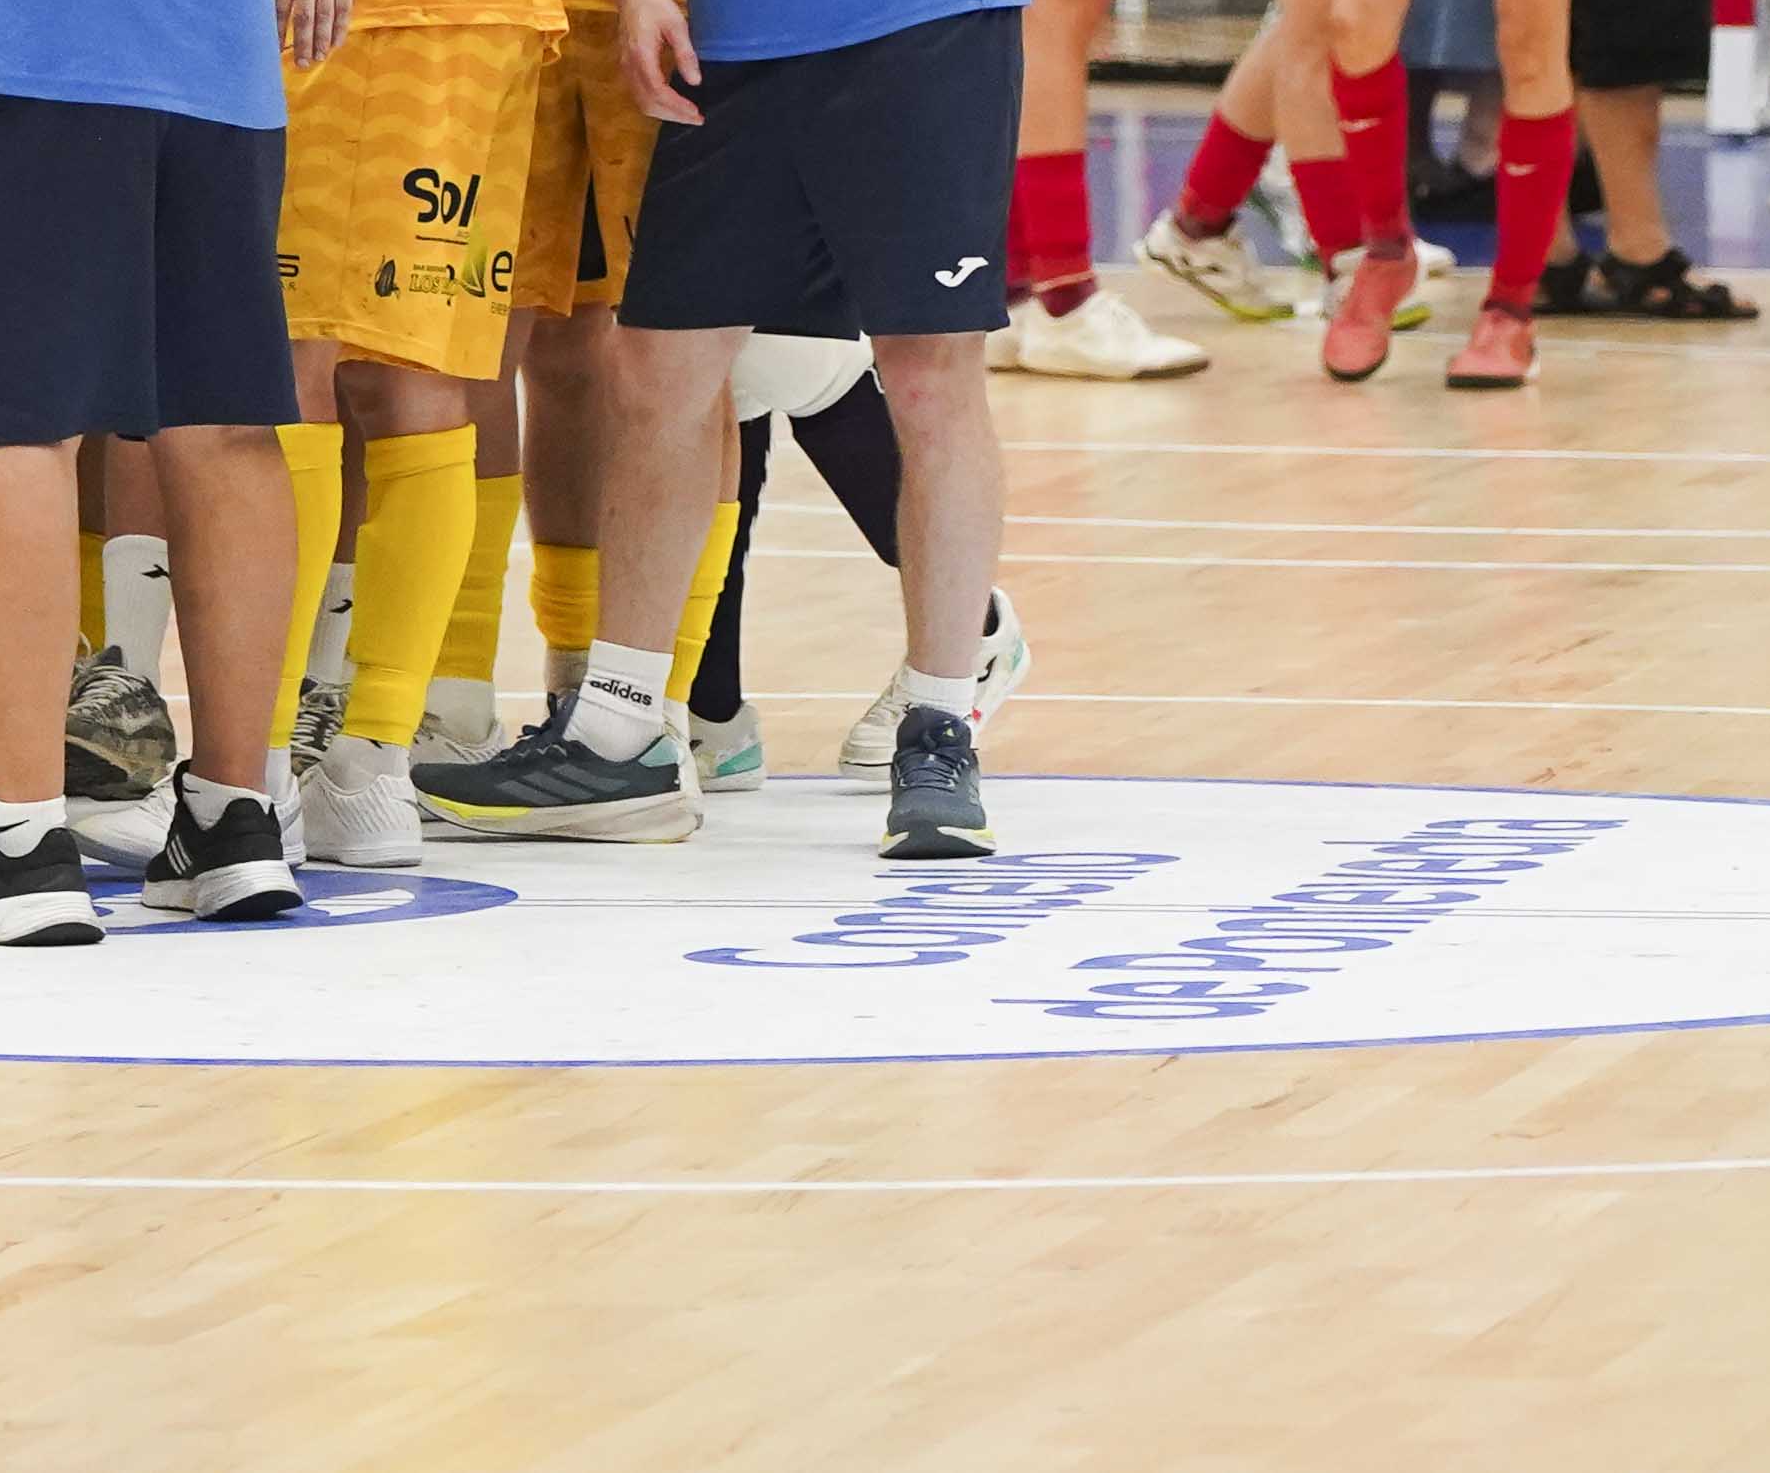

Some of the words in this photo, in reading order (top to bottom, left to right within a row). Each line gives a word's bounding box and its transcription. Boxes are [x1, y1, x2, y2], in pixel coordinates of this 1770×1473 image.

[589, 679, 653, 706] adidas
[683, 852, 1180, 969] Concello
[1066, 818, 1630, 973] Pontevedra
[990, 980, 1310, 1020] de
